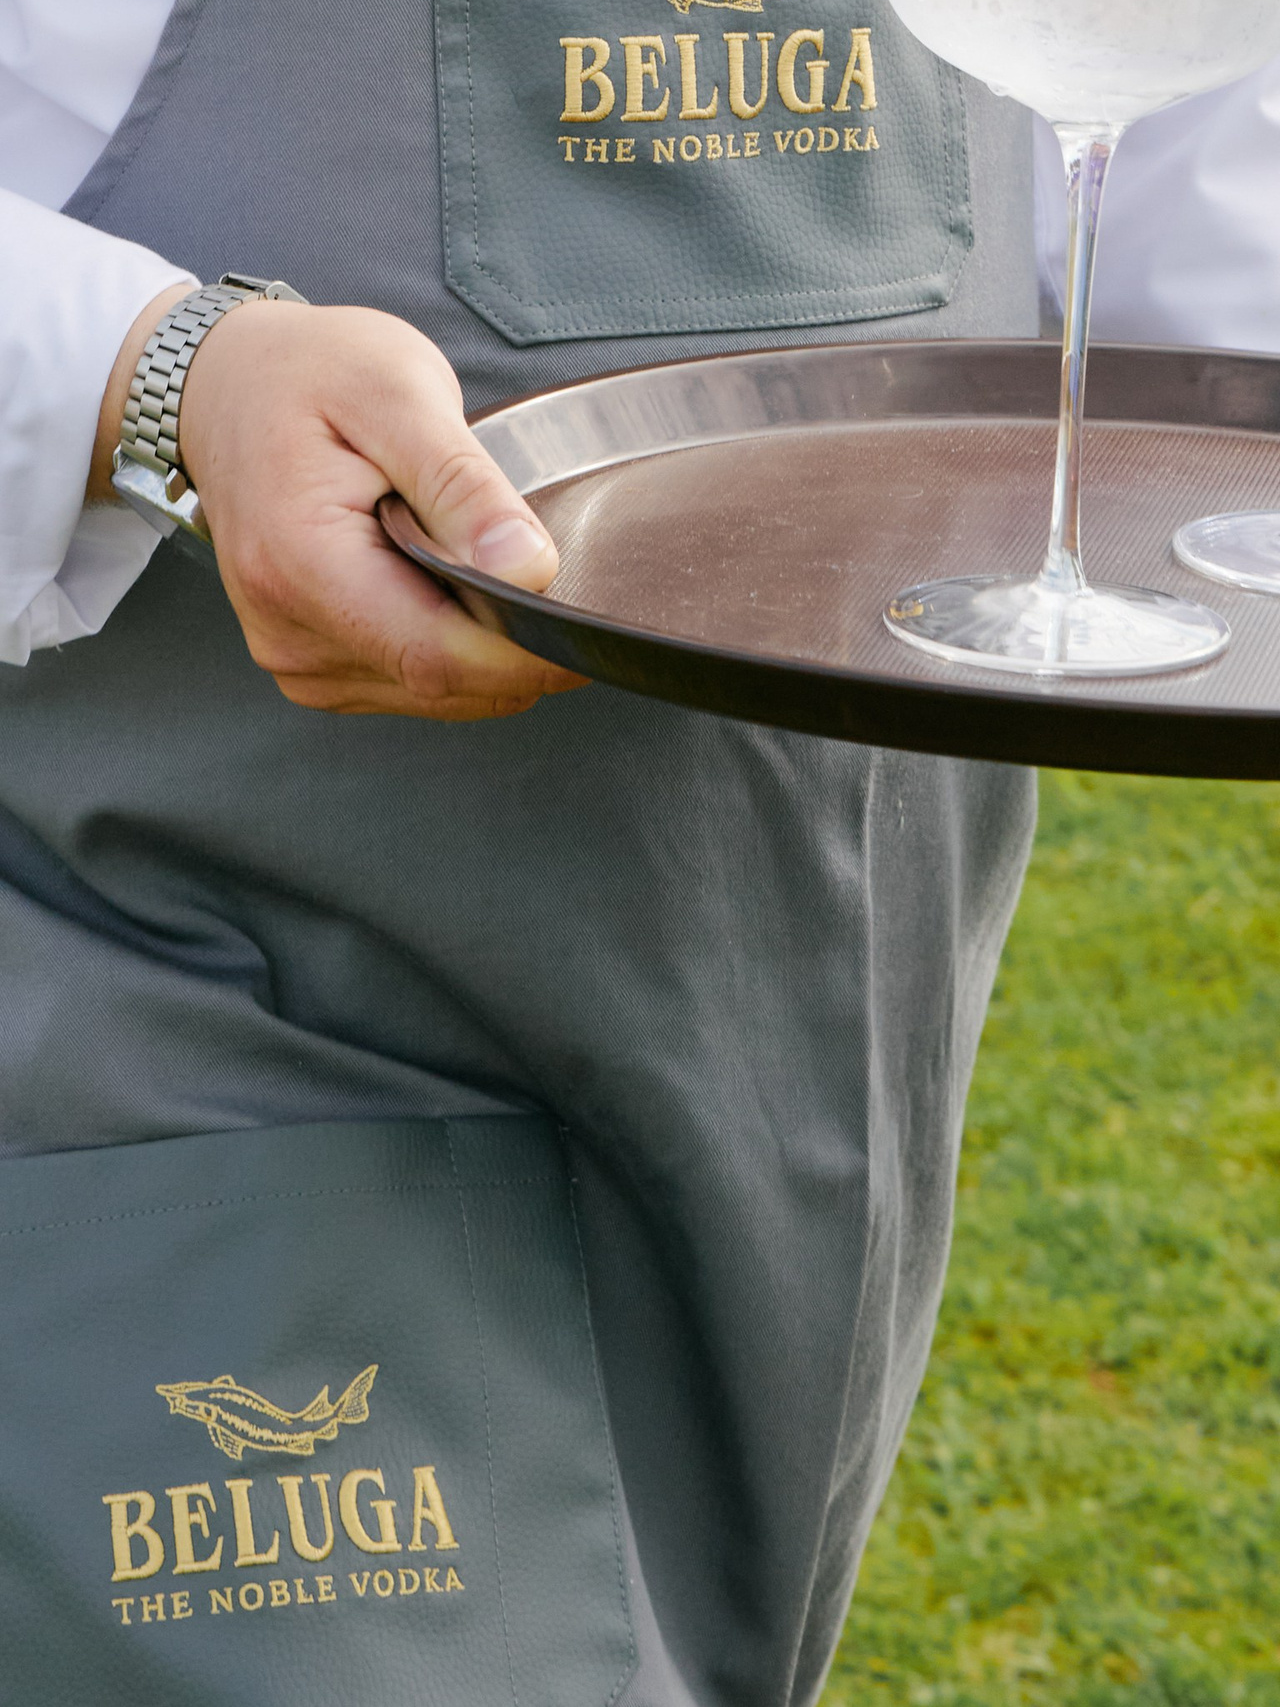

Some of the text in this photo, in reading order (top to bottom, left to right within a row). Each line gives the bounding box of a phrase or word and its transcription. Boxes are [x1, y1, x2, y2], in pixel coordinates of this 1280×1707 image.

[560, 27, 877, 123] BELUGA
[558, 126, 879, 163] THE NOBLE VODKA
[102, 1465, 460, 1582] BELUGA
[112, 1567, 465, 1625] THE NOBLE VODKA
